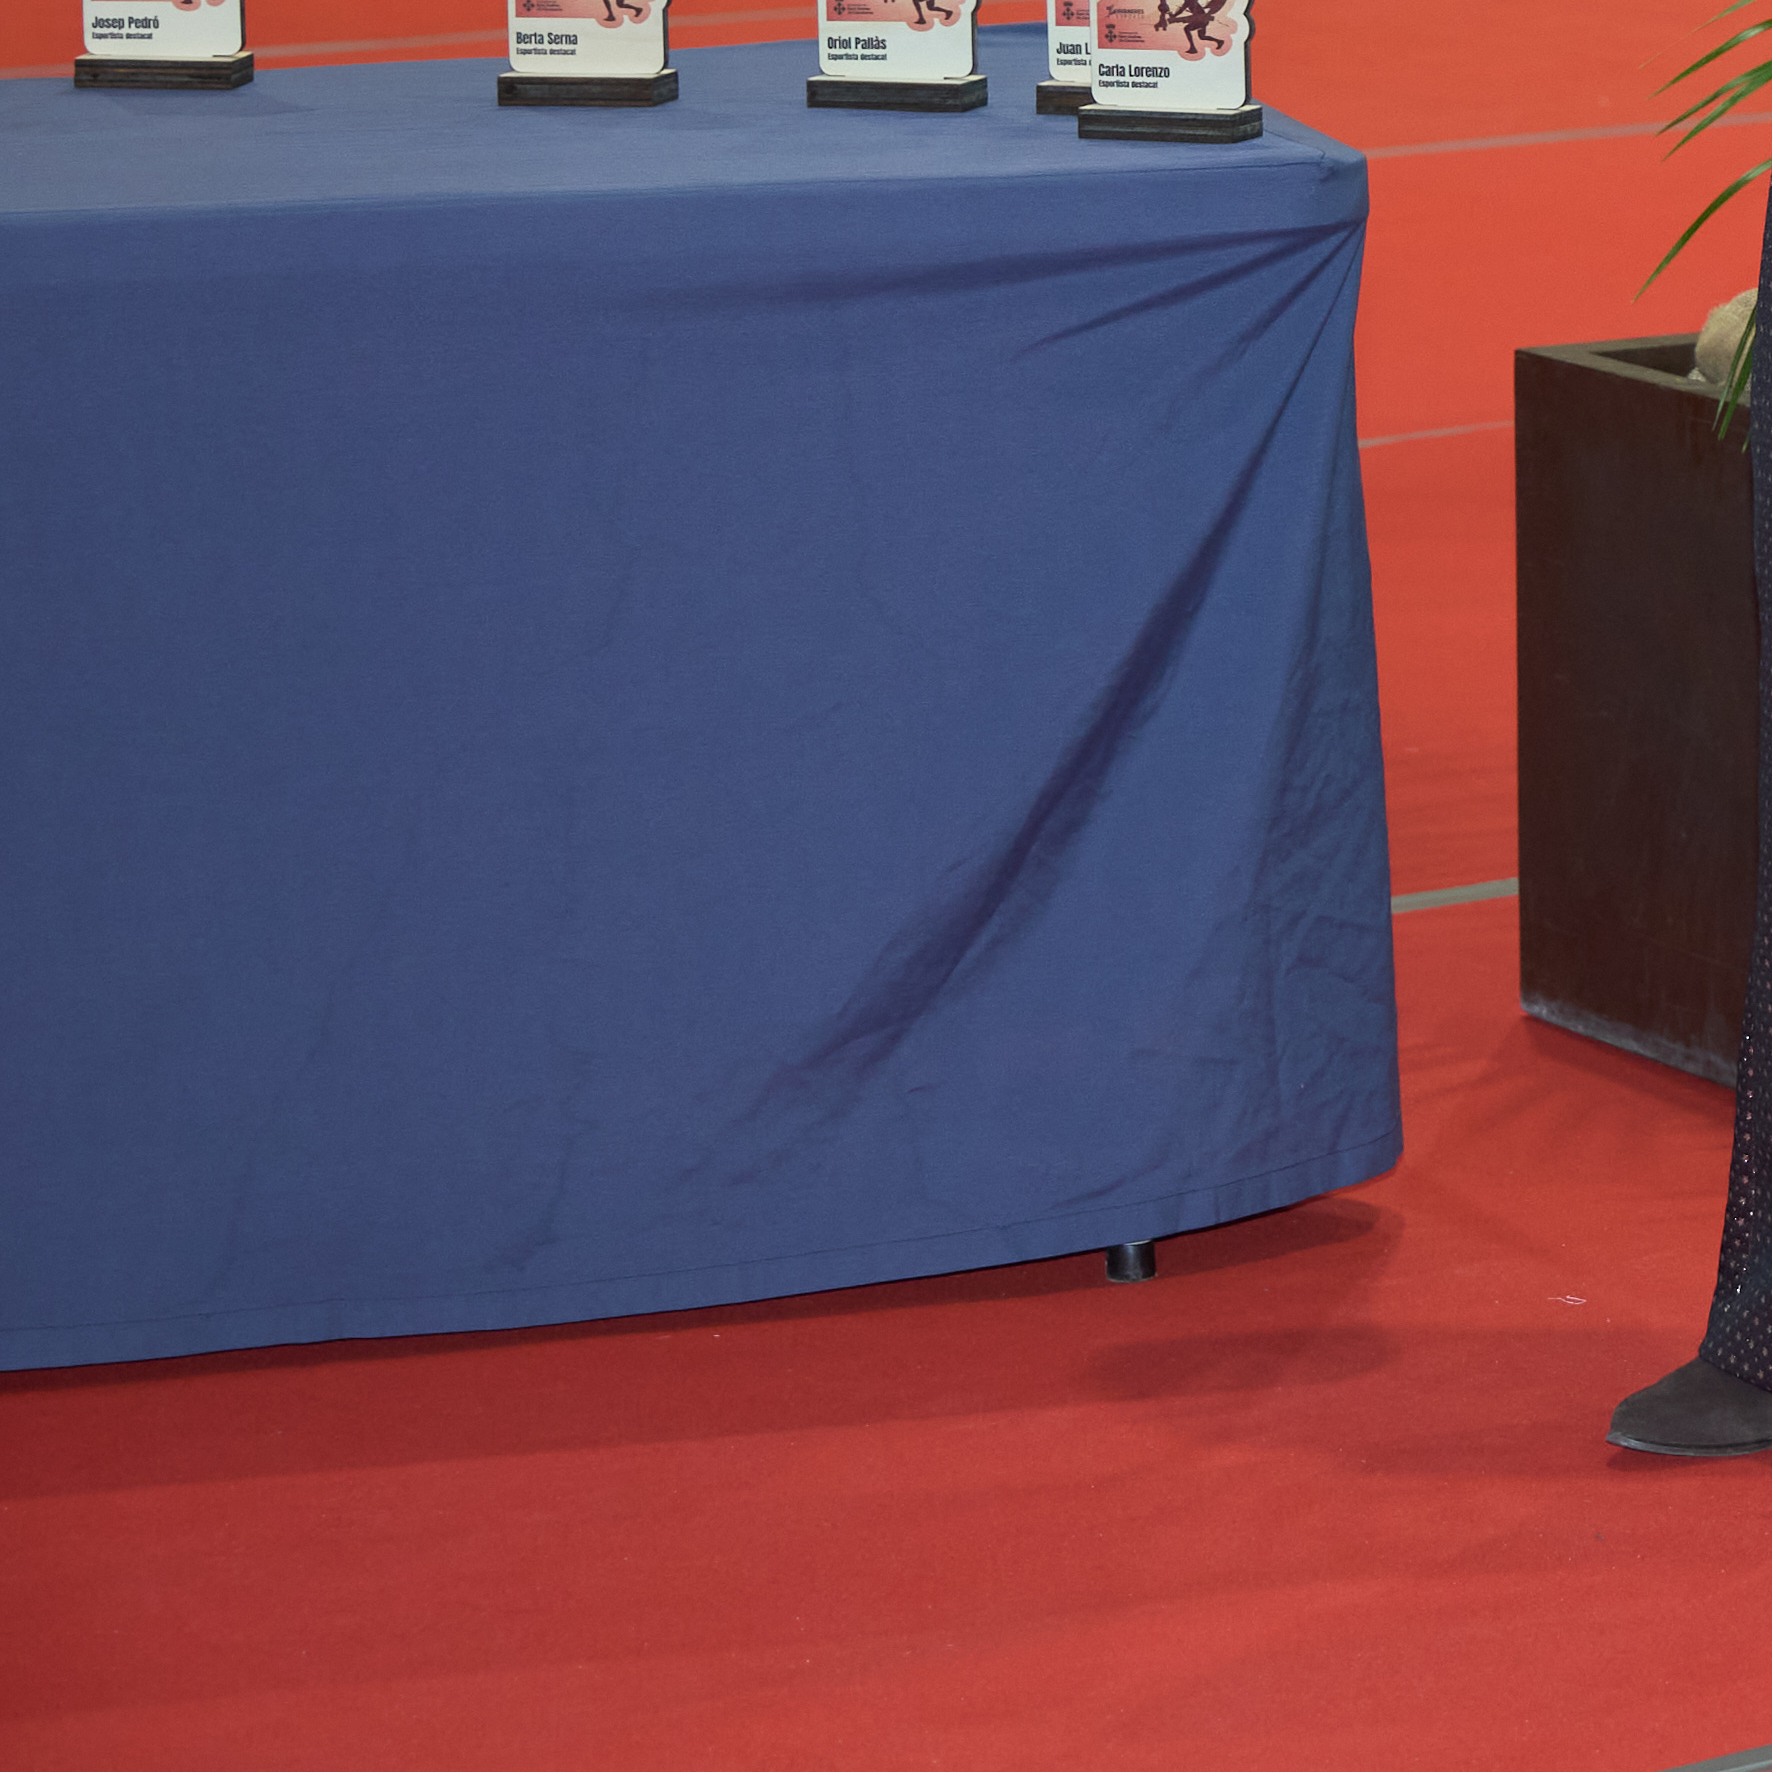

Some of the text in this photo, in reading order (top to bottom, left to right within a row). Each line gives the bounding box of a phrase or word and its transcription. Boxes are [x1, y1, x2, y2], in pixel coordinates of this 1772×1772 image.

[92, 16, 159, 30] Josep Pedró
[516, 32, 578, 45] Berta Serna
[827, 36, 887, 50] Oriol Pallàs
[1056, 42, 1082, 55] Juan
[828, 52, 858, 61] Esportista
[1098, 63, 1126, 77] Carla
[1129, 64, 1170, 78] Lorenzo
[1099, 79, 1130, 88] Esportista
